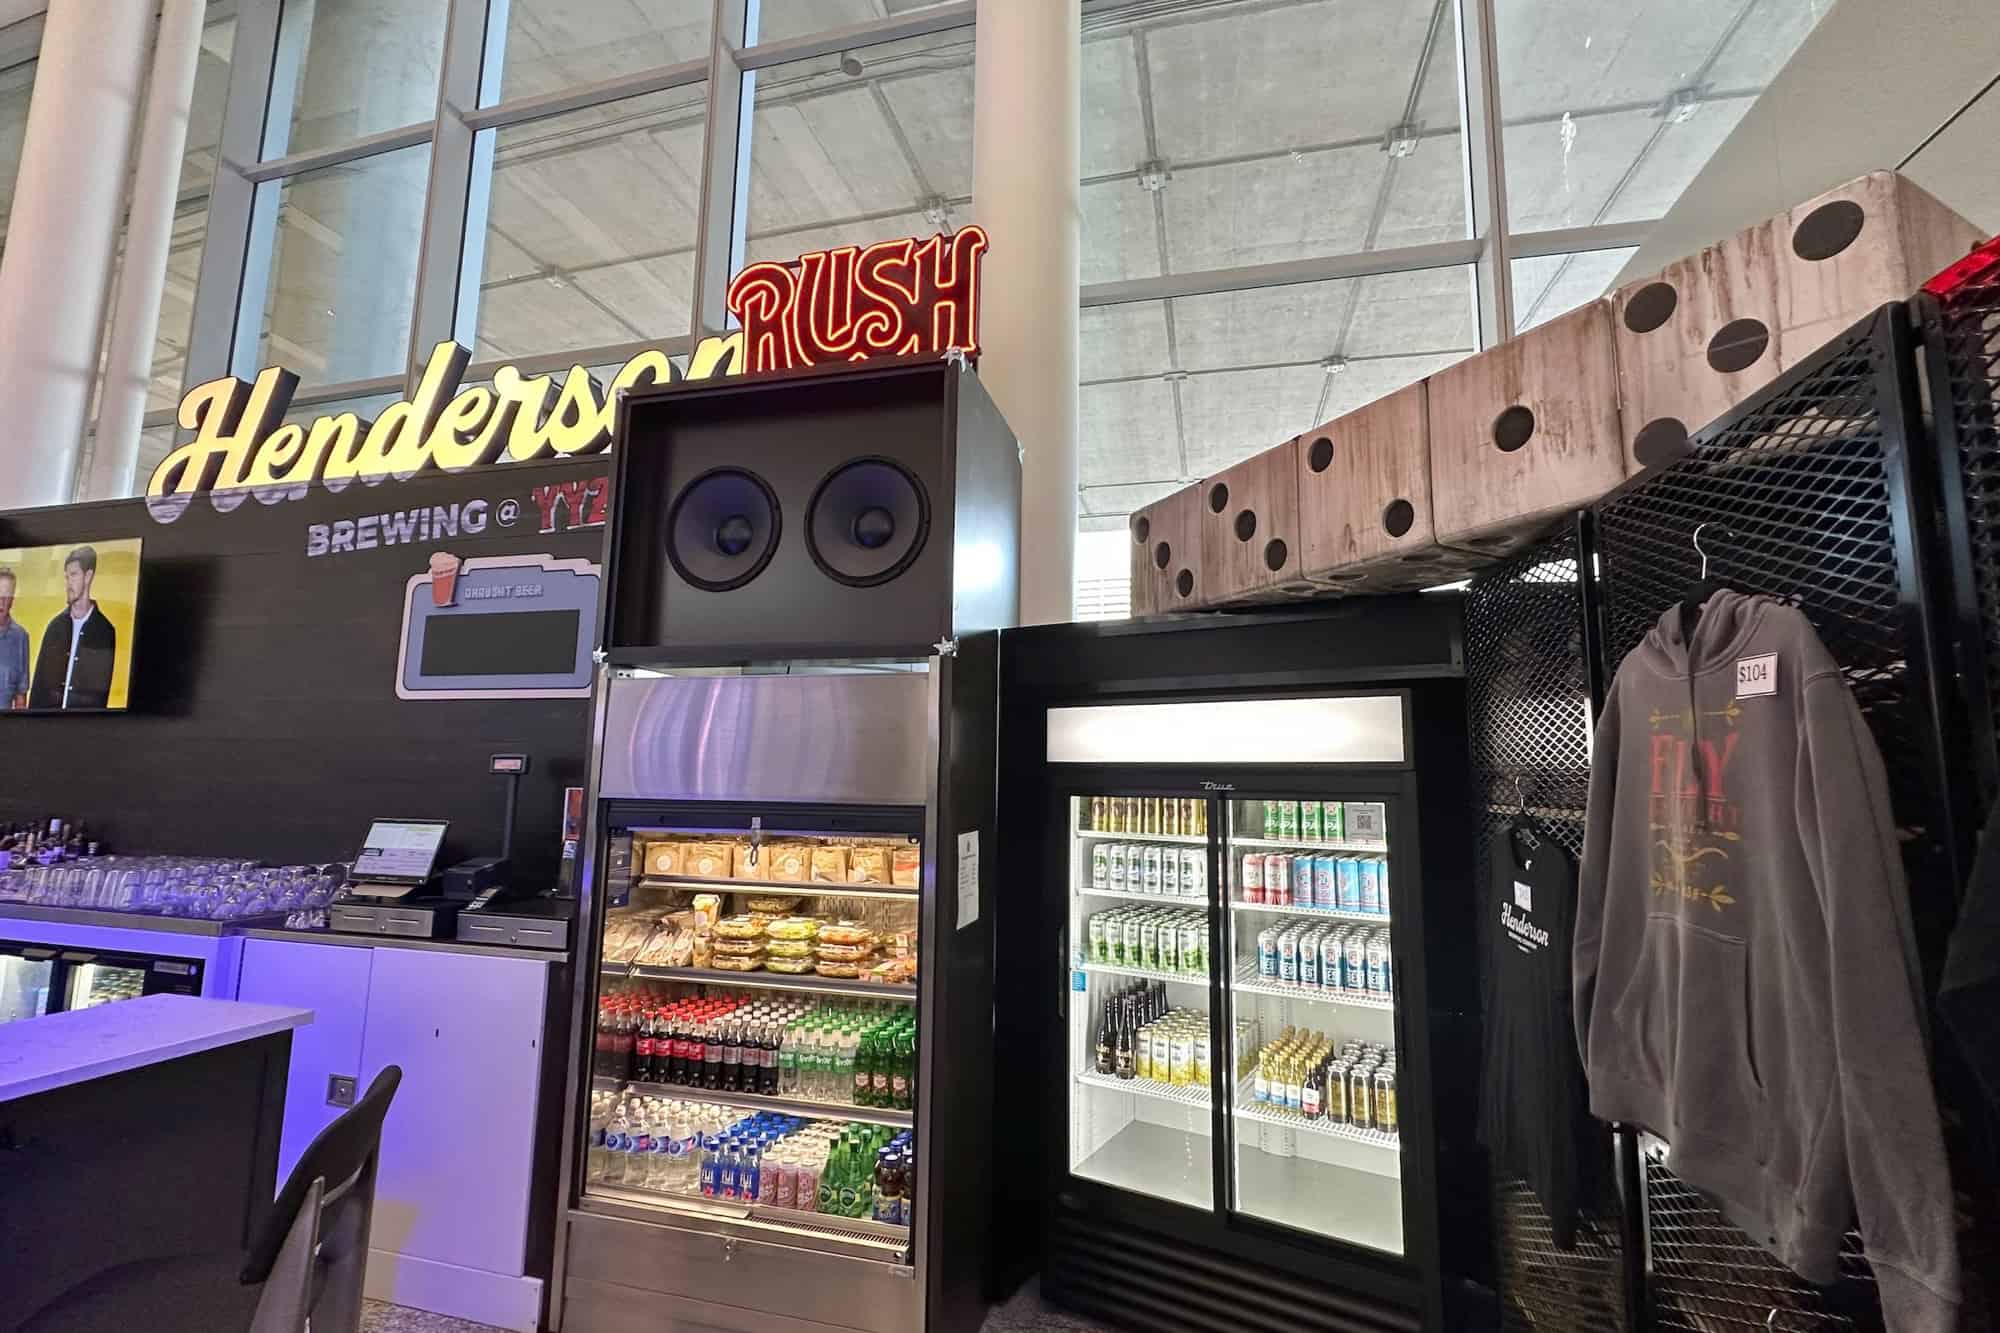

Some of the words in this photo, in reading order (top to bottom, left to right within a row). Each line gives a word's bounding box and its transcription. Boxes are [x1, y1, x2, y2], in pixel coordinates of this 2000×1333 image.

[727, 226, 989, 373] RUSH
[307, 499, 488, 556] BREWING
[495, 498, 521, 527] @
[1738, 663, 1767, 684] $104
[1649, 731, 1739, 797] FLY
[1501, 902, 1549, 947] Henderson
